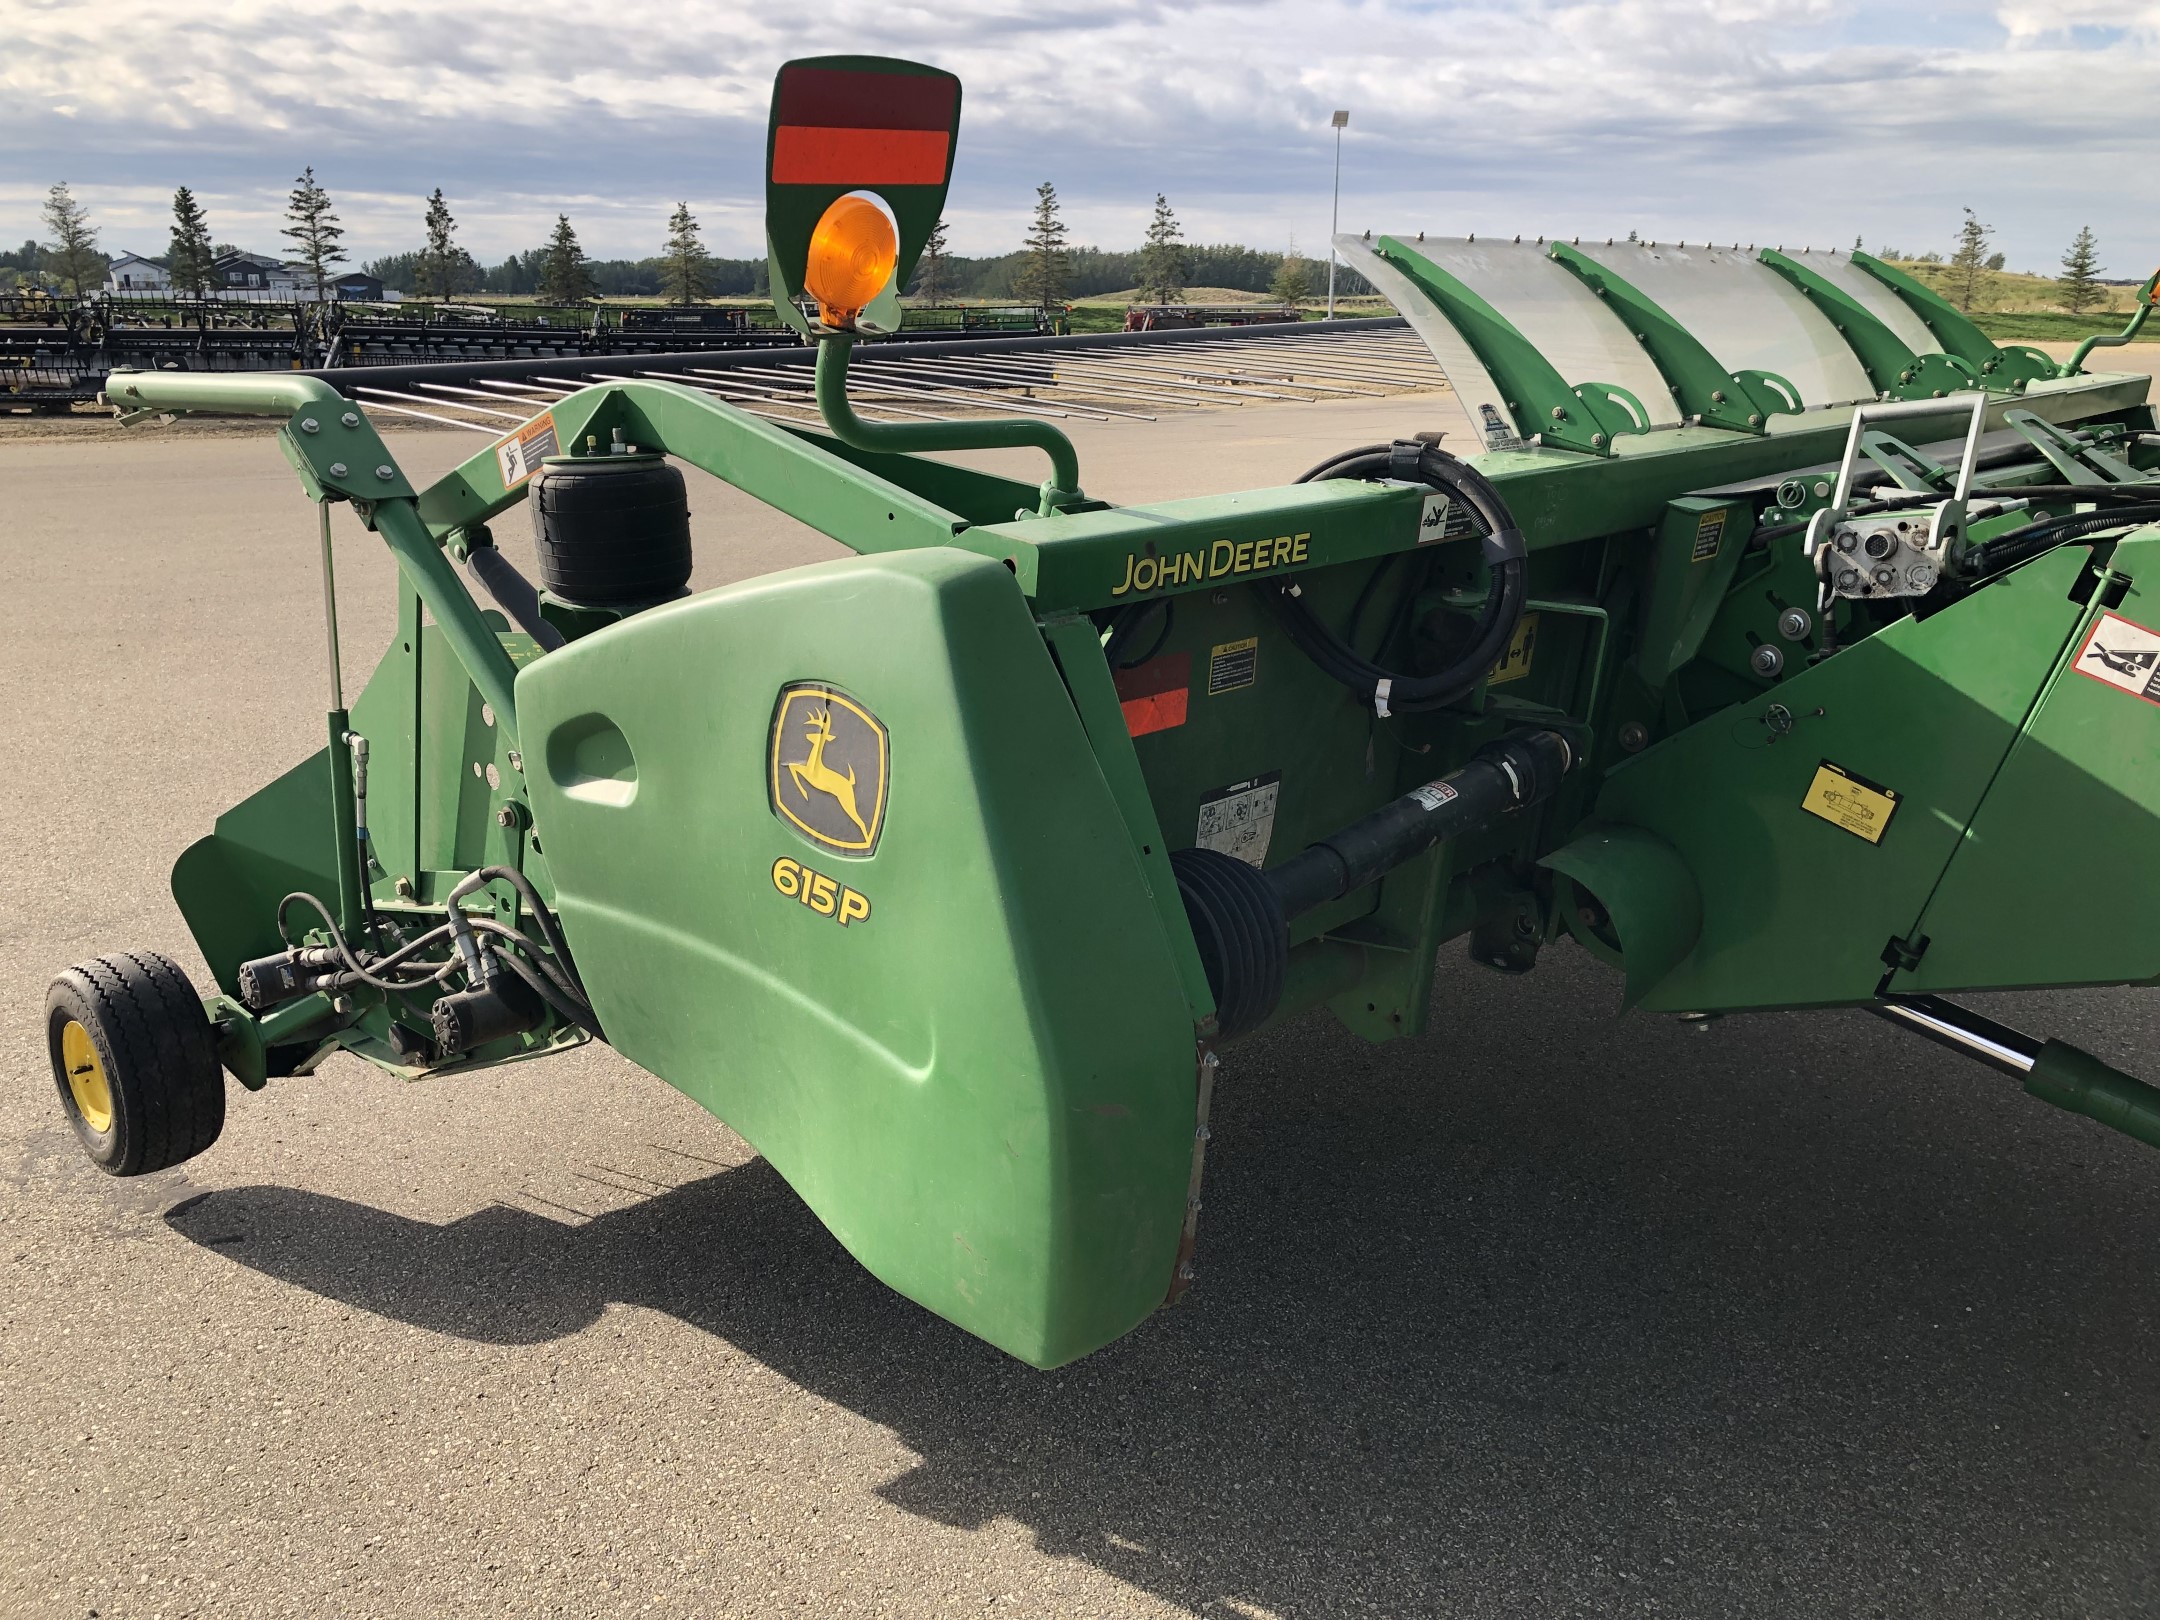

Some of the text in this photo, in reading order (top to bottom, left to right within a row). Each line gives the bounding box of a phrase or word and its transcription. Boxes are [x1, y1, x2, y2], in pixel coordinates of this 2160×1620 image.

[527, 416, 551, 437] WARNING
[1112, 532, 1310, 596] JOHN DEERE
[1228, 641, 1248, 651] CAUTION
[771, 857, 871, 928] 615P
